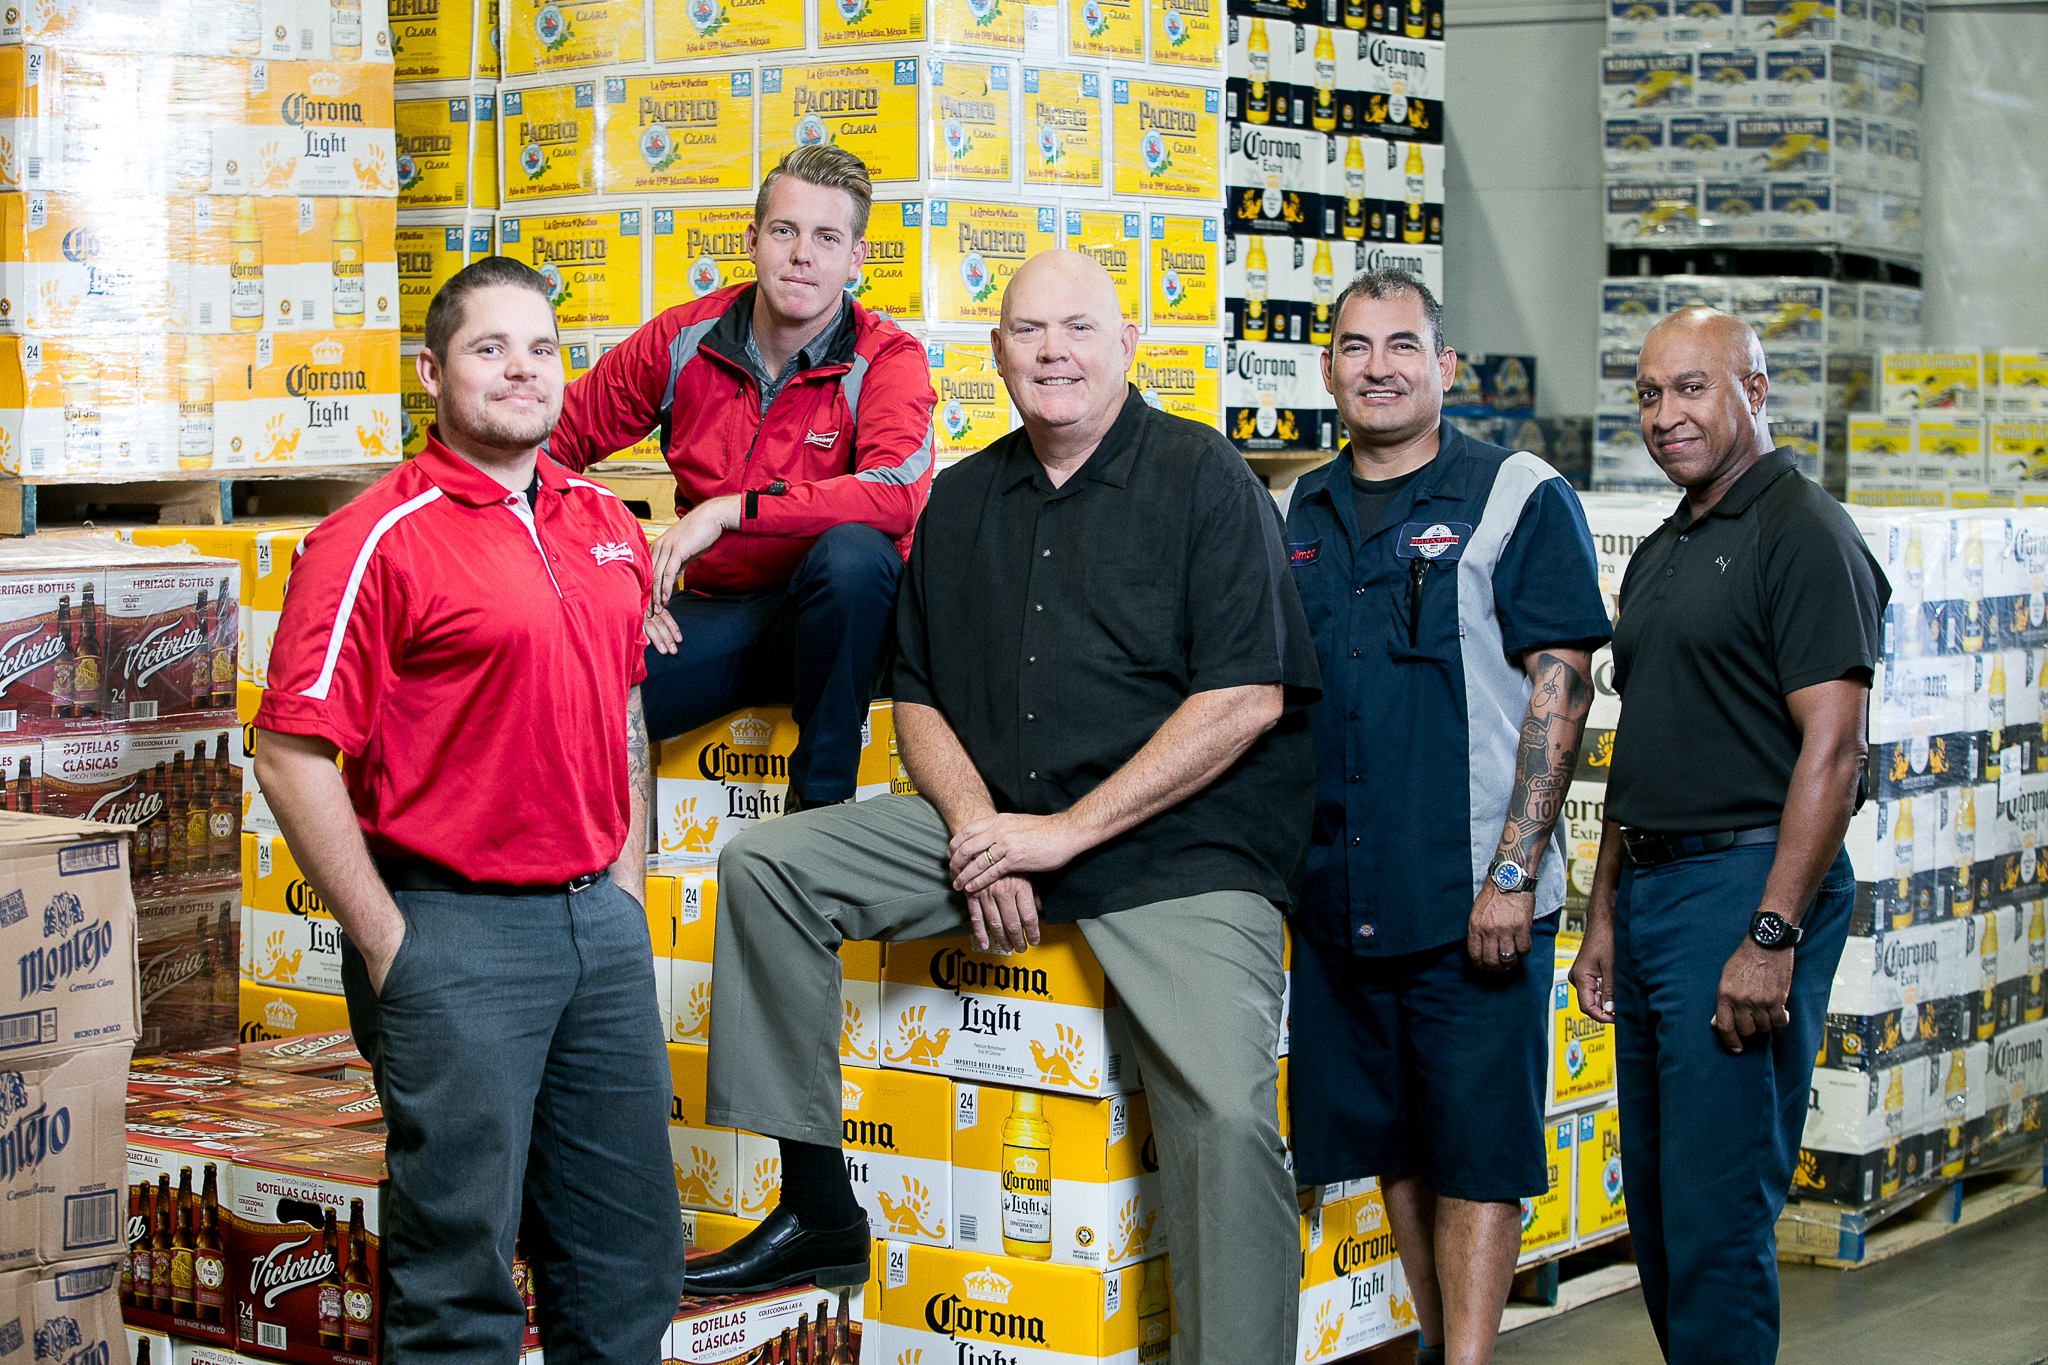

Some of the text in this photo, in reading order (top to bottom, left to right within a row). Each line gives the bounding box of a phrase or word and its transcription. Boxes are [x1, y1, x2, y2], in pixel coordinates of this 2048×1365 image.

[576, 10, 607, 22] CLARA
[405, 26, 437, 37] CLARA
[1370, 38, 1426, 71] Corona
[898, 61, 915, 72] 24
[1606, 58, 1646, 71] KIRIN
[1650, 57, 1688, 69] LIGHT
[734, 74, 750, 85] 24
[765, 71, 780, 81] 24
[1085, 75, 1097, 85] 24
[577, 86, 592, 96] 24
[610, 81, 624, 91] 24
[1115, 82, 1128, 92] 24
[507, 94, 520, 105] 24
[794, 87, 879, 117] PACIFICO
[1206, 91, 1217, 101] 24
[282, 93, 364, 129] Corona
[452, 100, 466, 110] 24
[639, 97, 718, 127] PACIFICO
[941, 96, 995, 120] PACIFICO
[1139, 101, 1196, 131] PACIFICO
[520, 122, 578, 145] PACIFICO
[841, 123, 877, 135] CLARA
[1739, 121, 1778, 134] KIRIN
[1783, 121, 1824, 133] LIGHT
[305, 131, 346, 158] Light
[684, 133, 717, 145] CLARA
[1173, 142, 1196, 153] CLARA
[1244, 130, 1301, 164] Corona
[425, 160, 449, 169] CLARA
[1653, 187, 1694, 199] LIGHT
[905, 204, 921, 215] 24
[932, 202, 946, 213] 24
[622, 213, 638, 224] 24
[656, 212, 672, 223] 24
[1126, 216, 1138, 227] 24
[1152, 218, 1163, 229] 24
[504, 221, 518, 231] 24
[1204, 221, 1215, 232] 24
[448, 229, 463, 240] 24
[474, 231, 488, 240] 24
[959, 222, 1026, 253] PACIFICO
[533, 237, 607, 265] PACIFICO
[1161, 248, 1206, 270] PACIFICO
[231, 261, 263, 279] Corona
[333, 260, 364, 278] Corona
[874, 268, 903, 279] CLARA
[574, 271, 605, 283] CLARA
[237, 283, 257, 295] Light
[338, 280, 358, 293] Light
[400, 284, 431, 295] CLARA
[260, 338, 269, 351] 24
[929, 345, 943, 356] 24
[1206, 345, 1217, 357] 24
[27, 345, 38, 359] 24
[572, 348, 586, 358] 24
[1239, 351, 1296, 384] Corona
[286, 364, 366, 400] Corona
[1137, 362, 1195, 389] PACIFICO
[941, 377, 995, 403] PACIFICO
[308, 401, 349, 428] Light
[259, 546, 269, 560] 24
[133, 577, 214, 589] HERITAGE BOTTLES
[124, 616, 202, 688] Victoria
[112, 689, 126, 703] 24
[64, 740, 120, 755] BOTELLAS
[132, 740, 162, 748] COLECCIONA
[63, 756, 118, 772] CLÁSICAS
[698, 741, 789, 786] Coron
[1535, 779, 1560, 788] COAST
[1539, 791, 1556, 799] HWY
[726, 786, 781, 819] Light
[1534, 800, 1558, 820] 101
[1571, 823, 1600, 841] Extr
[260, 846, 269, 860] 24
[685, 888, 697, 905] 24
[18, 918, 112, 1000] Montejo
[1884, 940, 1939, 981] Corona
[930, 947, 1050, 996] Corona
[959, 996, 1021, 1036] Light
[74, 1029, 92, 1039] HECHO
[93, 1027, 100, 1035] EN
[1588, 1043, 1605, 1054] CLARA
[1995, 1038, 2043, 1079] Corona
[953, 1058, 977, 1067] IMPORTED
[992, 1063, 1005, 1071] FROM
[1006, 1065, 1025, 1074] MEXICO
[960, 1092, 973, 1109] 24
[1114, 1105, 1125, 1122] 24
[1559, 1123, 1571, 1137] 24
[1581, 1117, 1593, 1130] 24
[842, 1119, 895, 1150] ona
[0, 1102, 70, 1184] ntejo
[126, 1152, 142, 1161] OLLECT
[144, 1155, 153, 1163] ALL
[1003, 1169, 1049, 1193] Corona
[256, 1182, 344, 1206] BOTELLAS CLÁSICAS
[1011, 1194, 1040, 1215] Light
[891, 1252, 904, 1269] 24
[250, 1234, 335, 1309] Victoria
[1108, 1278, 1118, 1296] 24
[1350, 1272, 1384, 1310] Light
[239, 1301, 254, 1319] 24
[351, 1301, 366, 1311] Victoria
[759, 1304, 788, 1317] COLECCIONA
[789, 1303, 798, 1312] LAS
[174, 1318, 185, 1326] BEER
[187, 1321, 199, 1329] MADE
[692, 1311, 747, 1336] BOTELLAS
[925, 1293, 1046, 1340] Corona
[692, 1329, 745, 1354] CLÁSICAS
